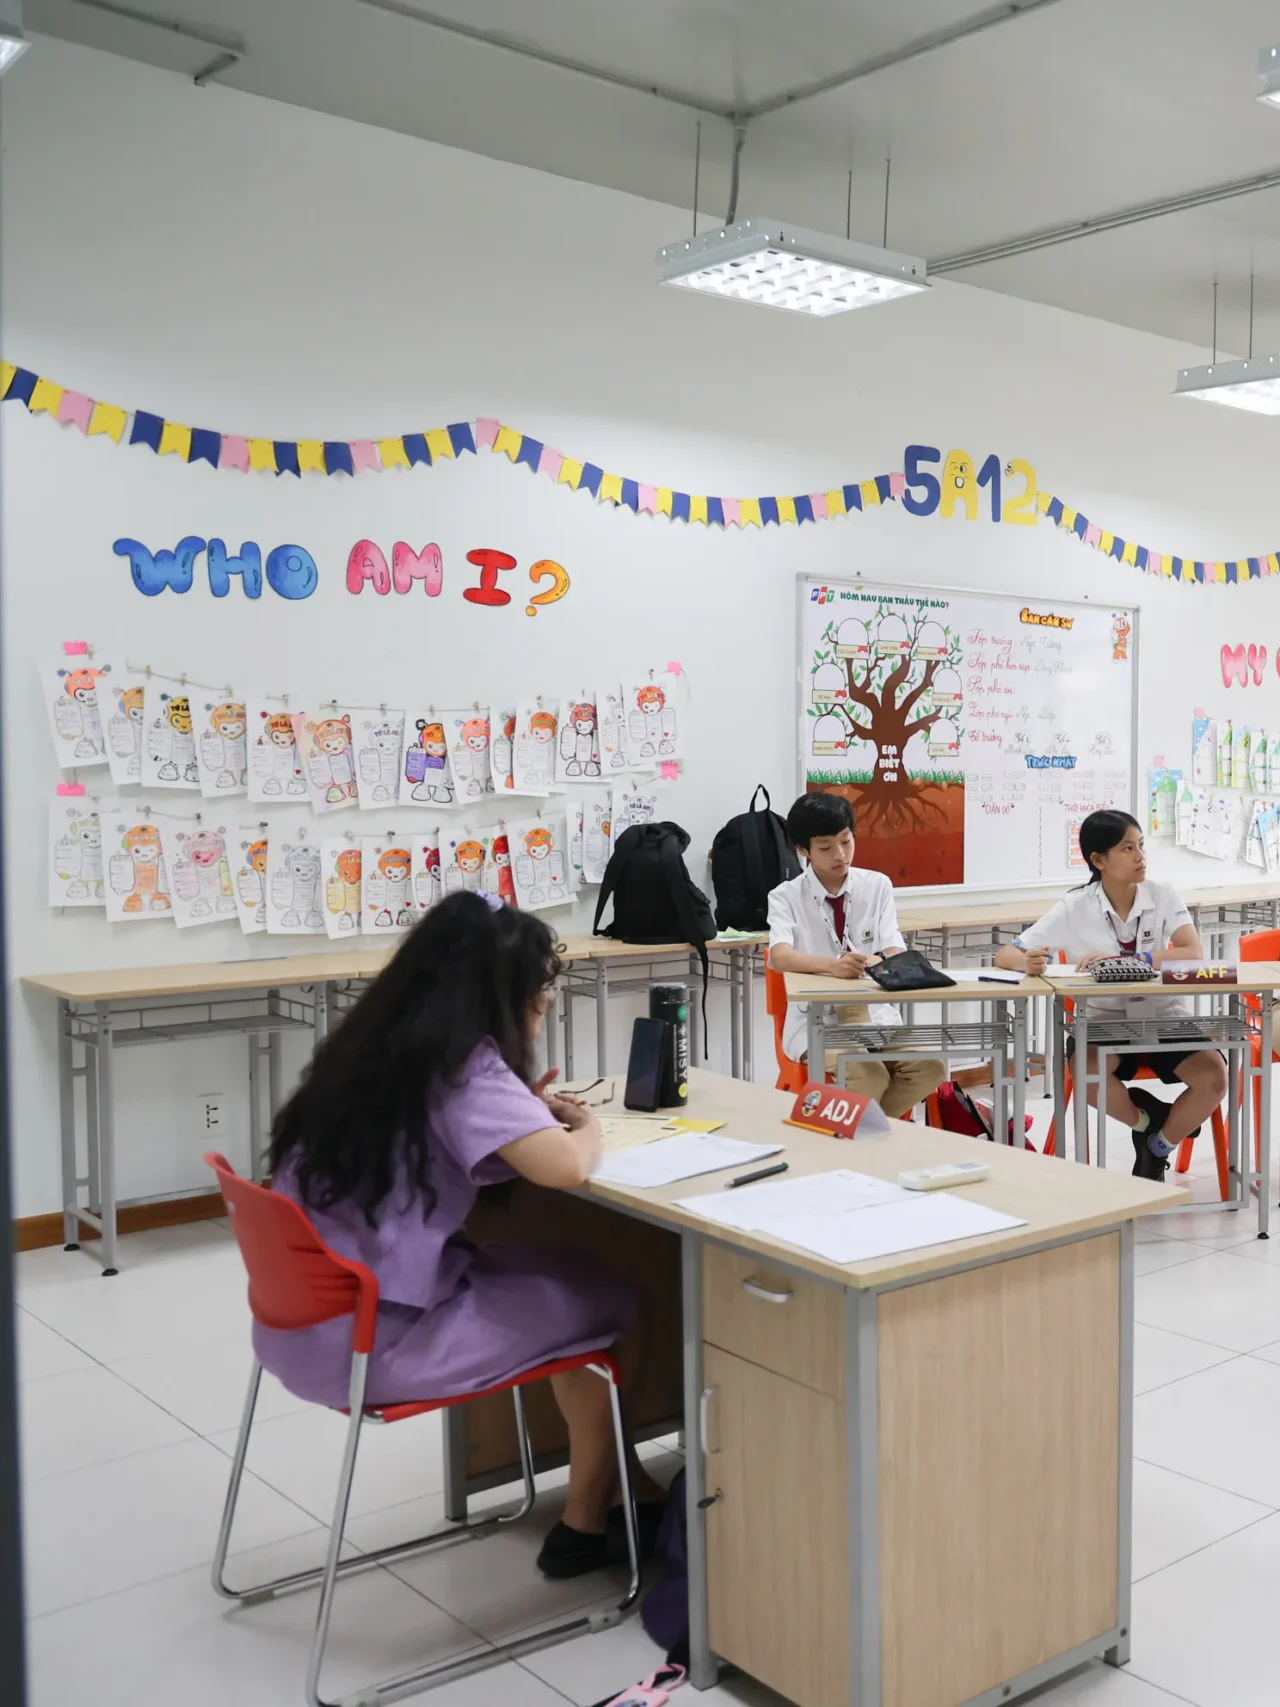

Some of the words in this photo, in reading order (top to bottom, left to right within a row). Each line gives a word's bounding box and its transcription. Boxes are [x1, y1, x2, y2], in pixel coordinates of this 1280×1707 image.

[902, 445, 1037, 526] 5A12
[113, 536, 318, 599] WHO
[346, 539, 442, 597] AM
[463, 549, 570, 617] I?
[811, 586, 835, 604] FPT
[1221, 643, 1267, 688] MY
[881, 744, 897, 755] EM
[1196, 965, 1228, 979] AFF
[679, 1038, 688, 1079] MISY
[819, 1098, 860, 1126] ADJ
